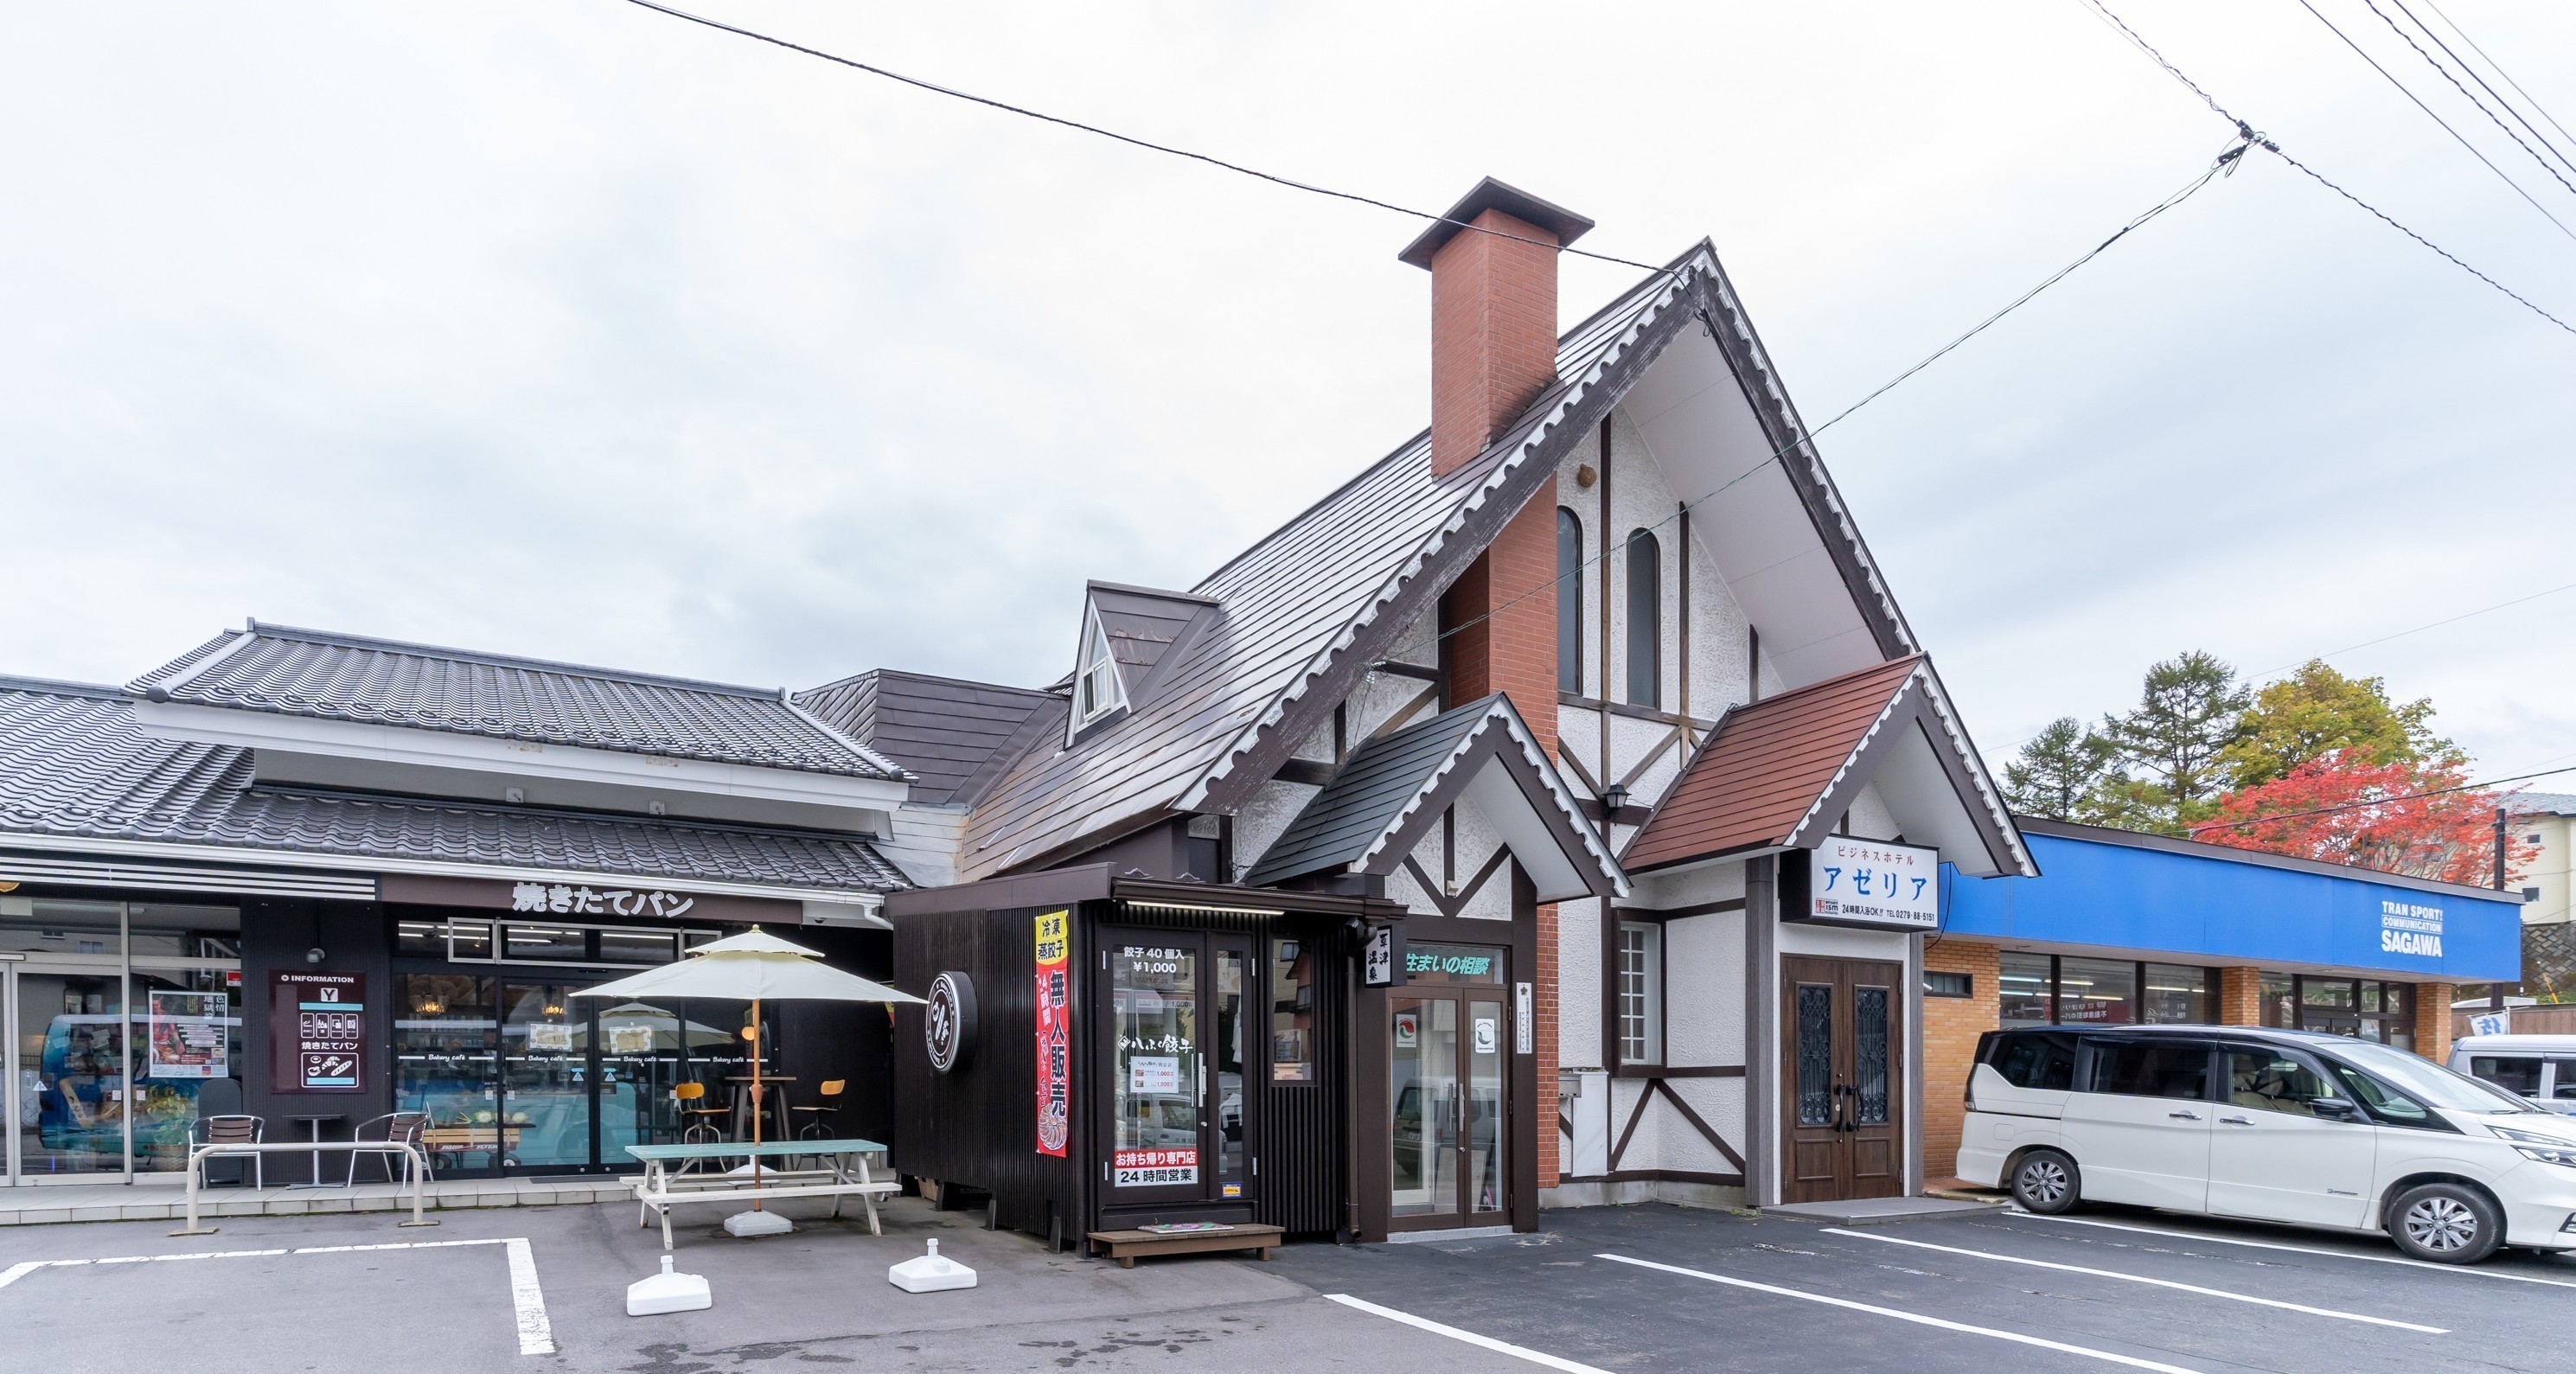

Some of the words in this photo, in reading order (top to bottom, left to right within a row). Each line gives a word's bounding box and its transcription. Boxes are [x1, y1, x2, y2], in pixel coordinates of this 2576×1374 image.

[1838, 846, 1914, 866] ビジネスホテル
[1823, 866, 1927, 901] アゼリア
[512, 881, 694, 918] 焼きたてパン
[1895, 910, 1934, 922] 0279-88-5151
[2382, 916, 2441, 933] COMMUNICATION
[1042, 917, 1061, 937] 冷凍
[1038, 939, 1064, 960] 蒸餃子
[1124, 946, 1144, 958] 餃子
[1147, 948, 1162, 958] 40
[1165, 948, 1185, 960] 個入
[2381, 930, 2443, 957] SAGAWA
[1133, 961, 1177, 974] ¥1,000
[1368, 950, 1378, 981] 温泉
[1406, 953, 1491, 975] 住まいの相談
[291, 975, 355, 983] INFORMATION
[301, 1041, 358, 1050] 焼きたてパン
[1049, 969, 1066, 1117] 無人販売
[1131, 1033, 1193, 1053] 八ふく餃子
[1115, 1151, 1196, 1166] お持ち帰り専門店
[1120, 1171, 1140, 1183] 24
[1142, 1168, 1192, 1183] 時間営業
